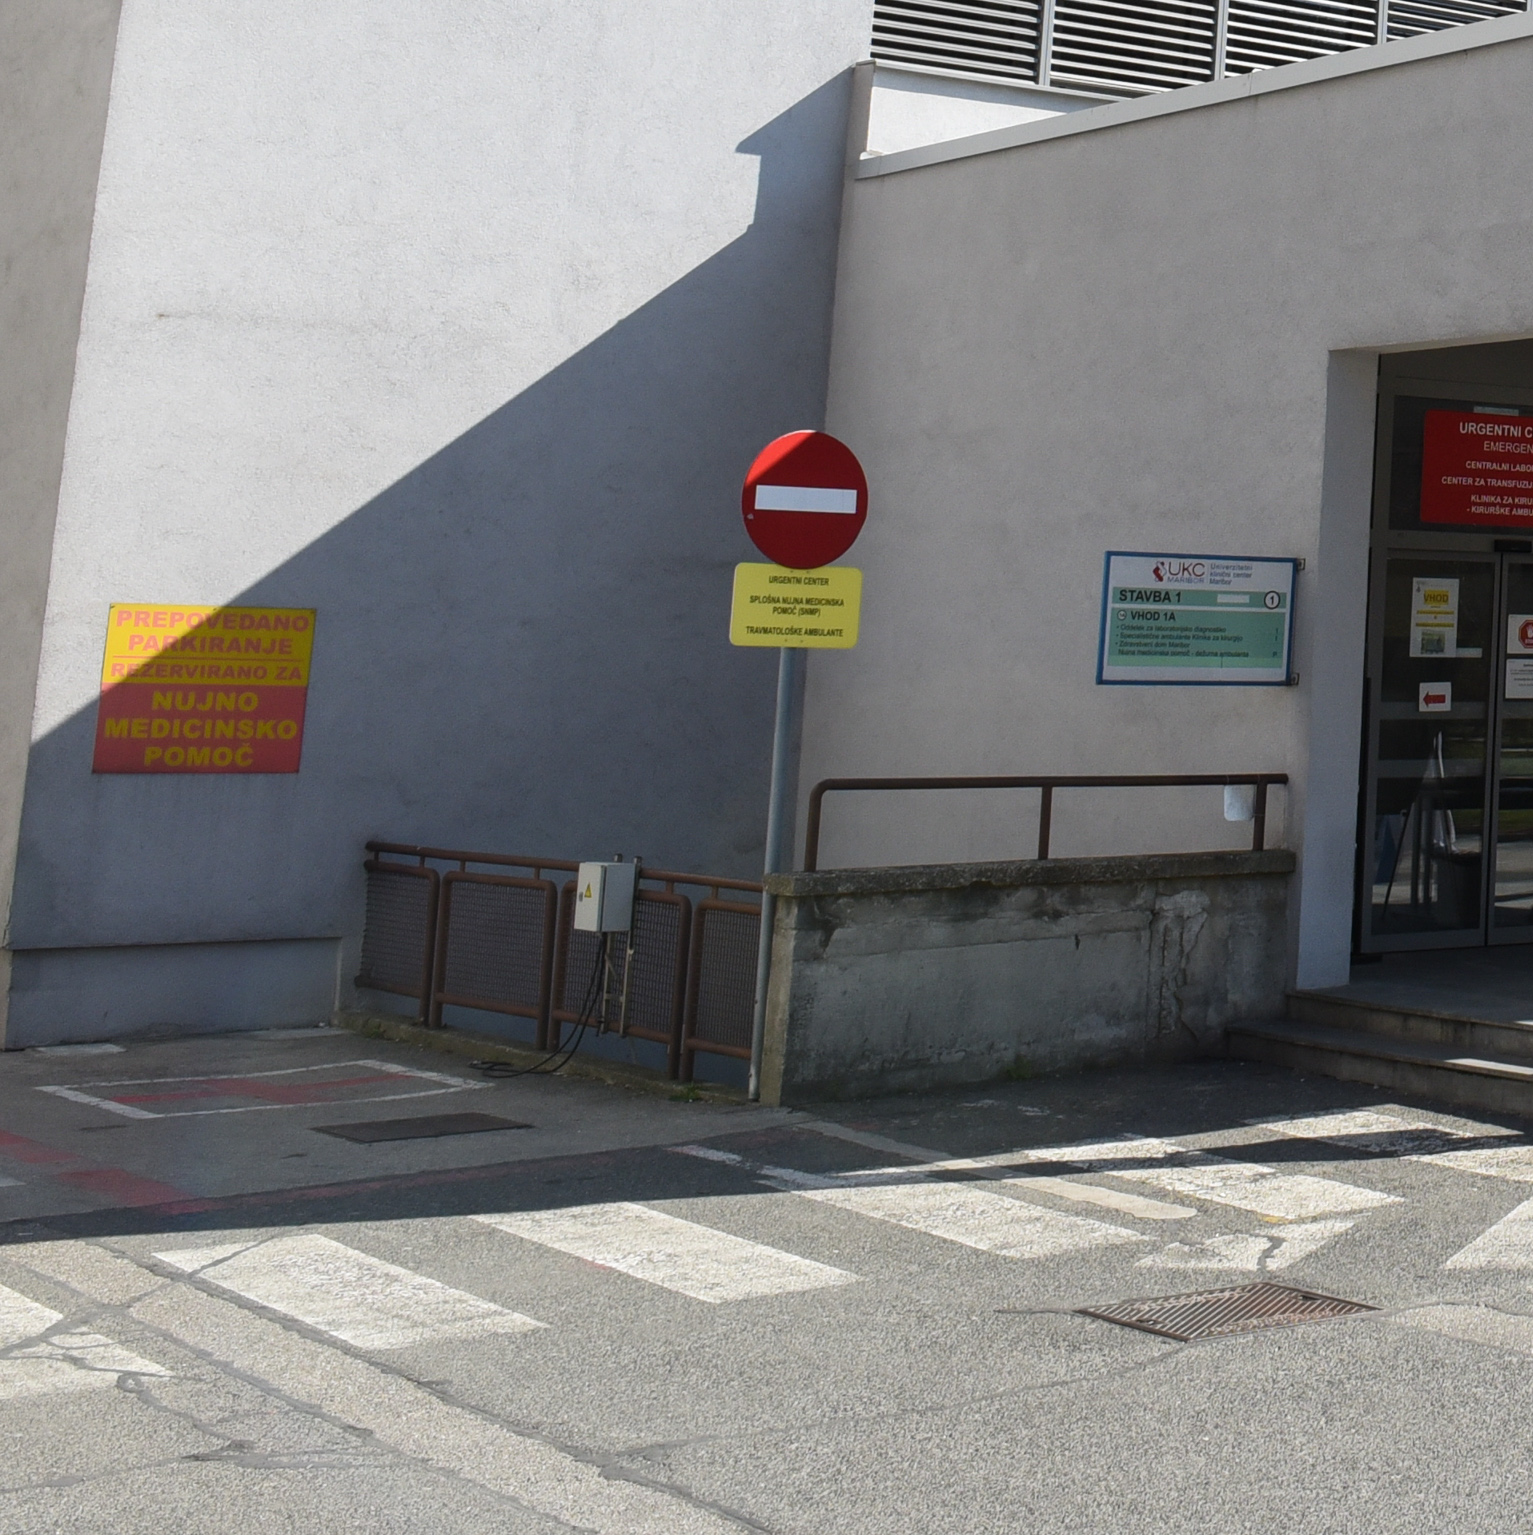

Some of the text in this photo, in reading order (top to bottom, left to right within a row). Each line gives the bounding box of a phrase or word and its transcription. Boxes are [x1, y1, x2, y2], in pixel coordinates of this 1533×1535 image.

[1459, 421, 1521, 438] URGENTNI
[1466, 460, 1509, 472] CENTRALNI
[1441, 476, 1473, 486] CENTER
[1474, 478, 1486, 487] ZA
[1471, 495, 1501, 504] KLINIKA
[1502, 496, 1513, 505] ZA
[1471, 504, 1510, 515] KIRURŠKE
[1168, 562, 1205, 578] UKC
[768, 575, 829, 586] URGENTNI CENTER
[1166, 576, 1204, 584] MARIBOR
[749, 593, 845, 607] SPLOŠNA NUJNA MEDICINSKA
[1119, 589, 1182, 604] STAVBA 1
[1424, 593, 1449, 603] VHOD
[772, 605, 797, 615] POMOČ
[1131, 611, 1176, 621] VHOD 1A
[115, 610, 310, 632] PREPOVEDANO
[746, 625, 844, 637] TRAVMATOLOŠKE AMBULANTE
[128, 634, 293, 655] PARKIRANJE
[110, 662, 302, 681] REZERVIRANO ZA
[151, 691, 259, 712] NUJNO
[104, 718, 298, 740] MEDICINSKO
[143, 742, 254, 767] POMOČ
